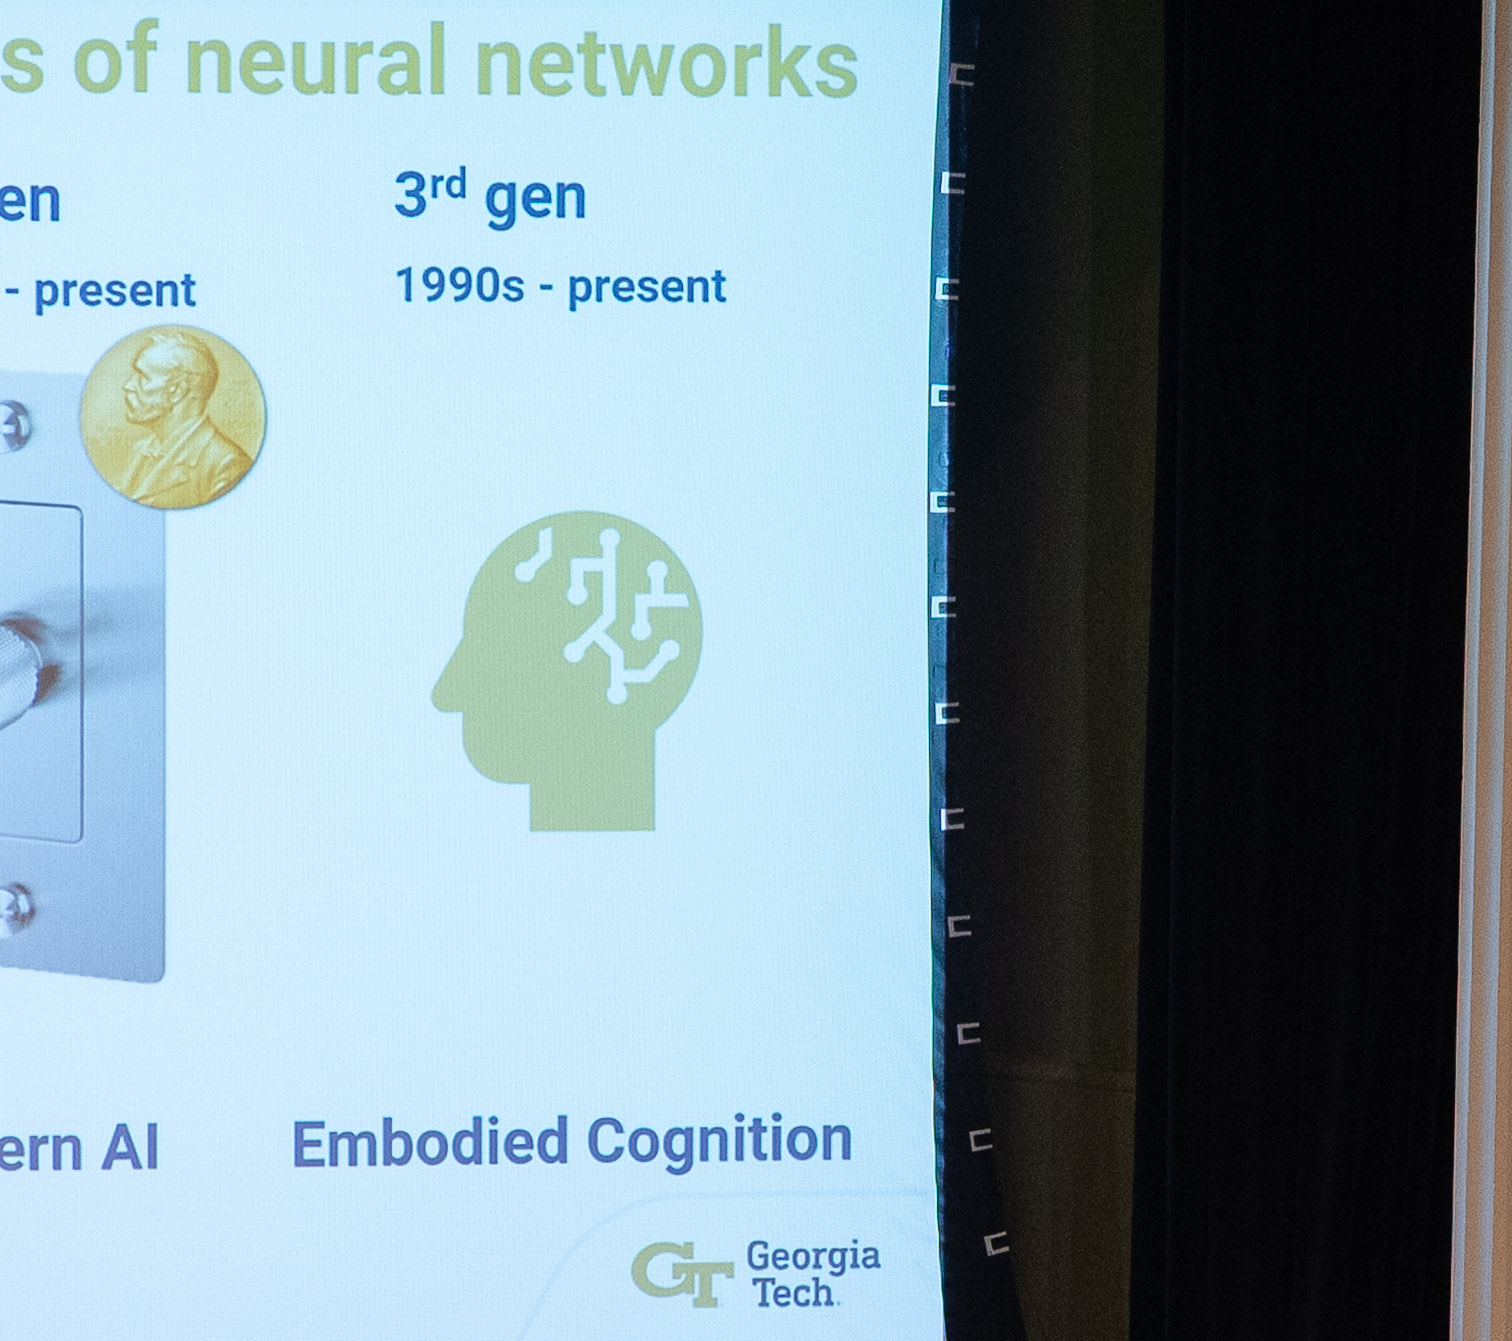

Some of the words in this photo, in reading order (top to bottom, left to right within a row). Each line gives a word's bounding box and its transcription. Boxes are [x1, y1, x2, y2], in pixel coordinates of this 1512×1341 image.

[74, 17, 160, 95] of
[187, 20, 445, 96] neural
[477, 22, 858, 99] networks
[394, 165, 467, 218] 3rd
[485, 181, 586, 232] gen
[35, 273, 197, 317] present
[396, 265, 525, 303] 1990s
[568, 269, 727, 313] present
[101, 1122, 158, 1171] AI
[294, 1114, 568, 1168] Embodied
[587, 1111, 852, 1176] Cognition
[630, 1241, 735, 1308] GT
[747, 1239, 882, 1277] Georgia
[752, 1276, 835, 1308] Tech
